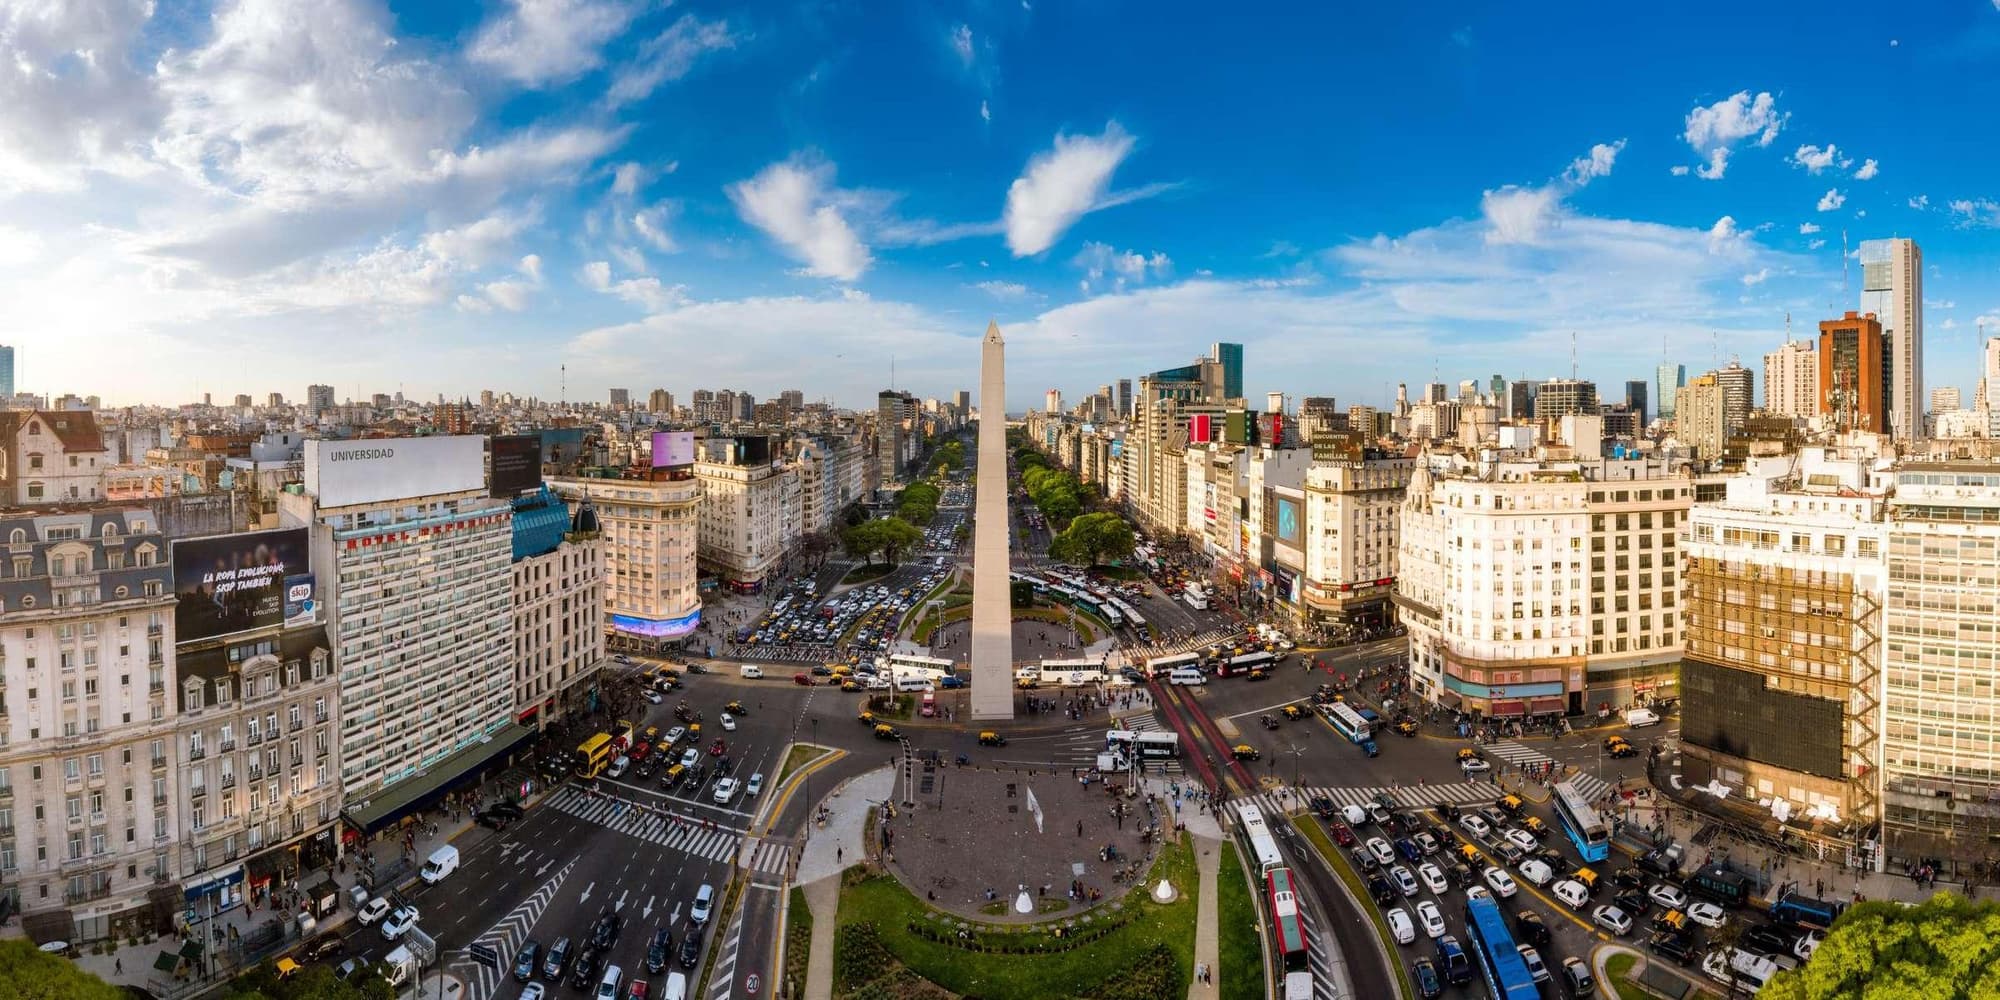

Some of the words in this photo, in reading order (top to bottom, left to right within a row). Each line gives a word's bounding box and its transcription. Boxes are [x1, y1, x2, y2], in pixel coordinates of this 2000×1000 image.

[330, 448, 394, 462] UNIVERSIDAD
[347, 531, 409, 549] HOTEL
[203, 573, 214, 583] LA
[216, 569, 236, 581] ROPA
[216, 581, 236, 593] SKIP
[291, 586, 309, 600] skip
[748, 977, 759, 990] 20
